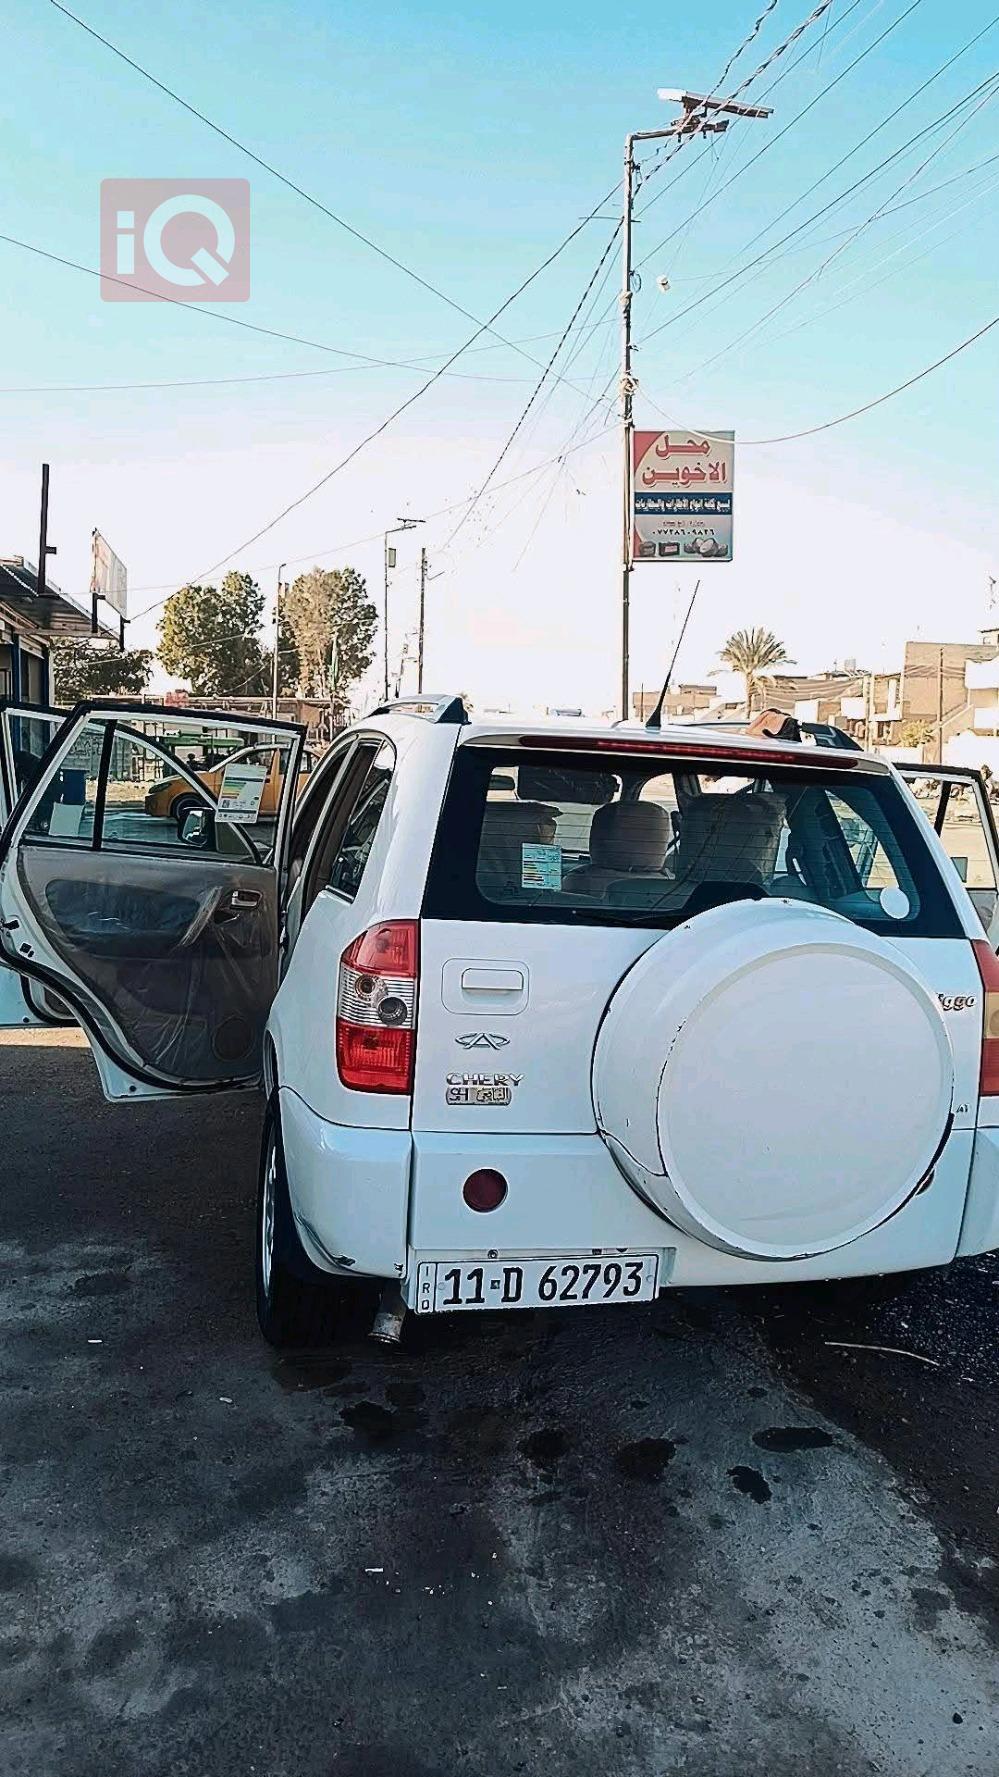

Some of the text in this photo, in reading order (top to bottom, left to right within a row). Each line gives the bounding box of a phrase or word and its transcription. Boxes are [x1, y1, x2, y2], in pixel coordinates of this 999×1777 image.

[655, 434, 711, 458] محل
[642, 461, 727, 487] الاخوين
[446, 1071, 524, 1087] CHERY
[538, 1262, 644, 1302] 62793
